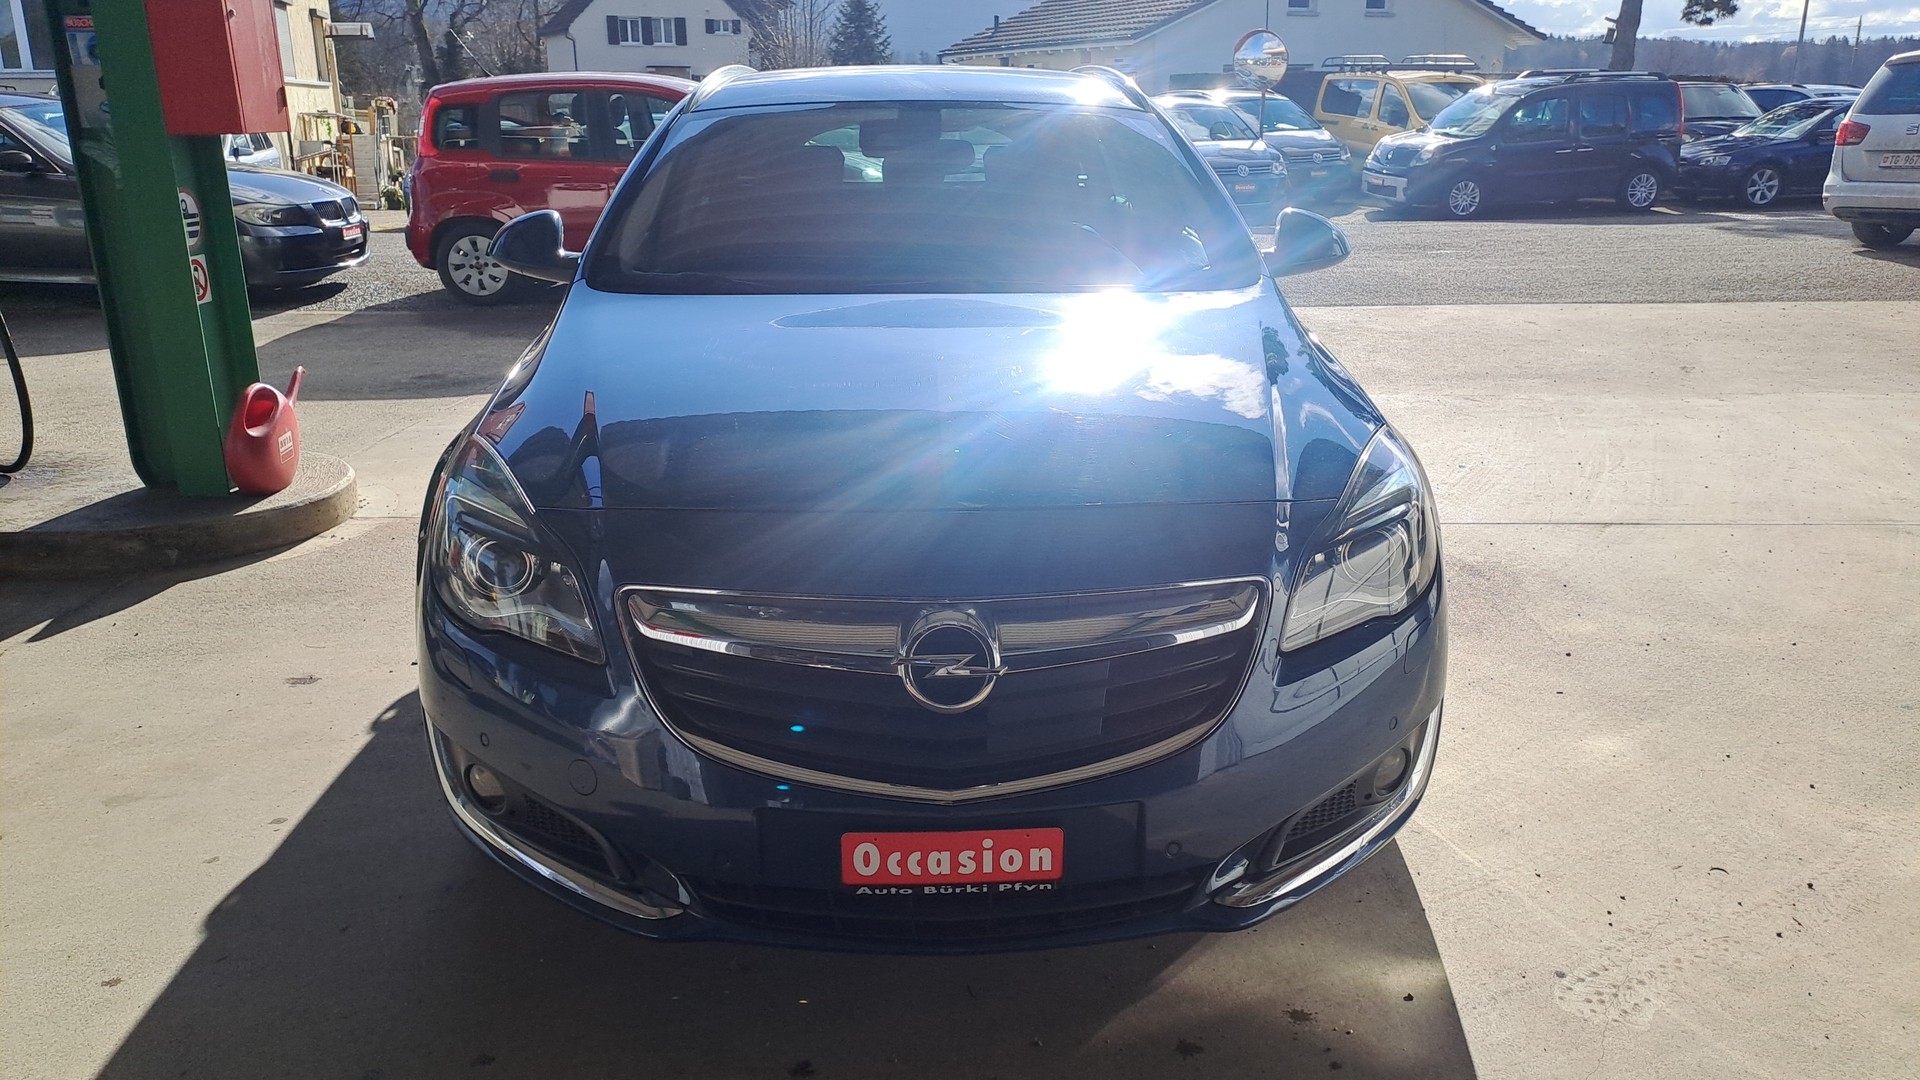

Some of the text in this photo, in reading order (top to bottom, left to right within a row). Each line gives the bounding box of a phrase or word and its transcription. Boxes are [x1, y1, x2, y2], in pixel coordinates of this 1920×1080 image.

[853, 838, 1052, 876] Occasion
[856, 882, 1052, 895] Auto Bürki Pfyn
